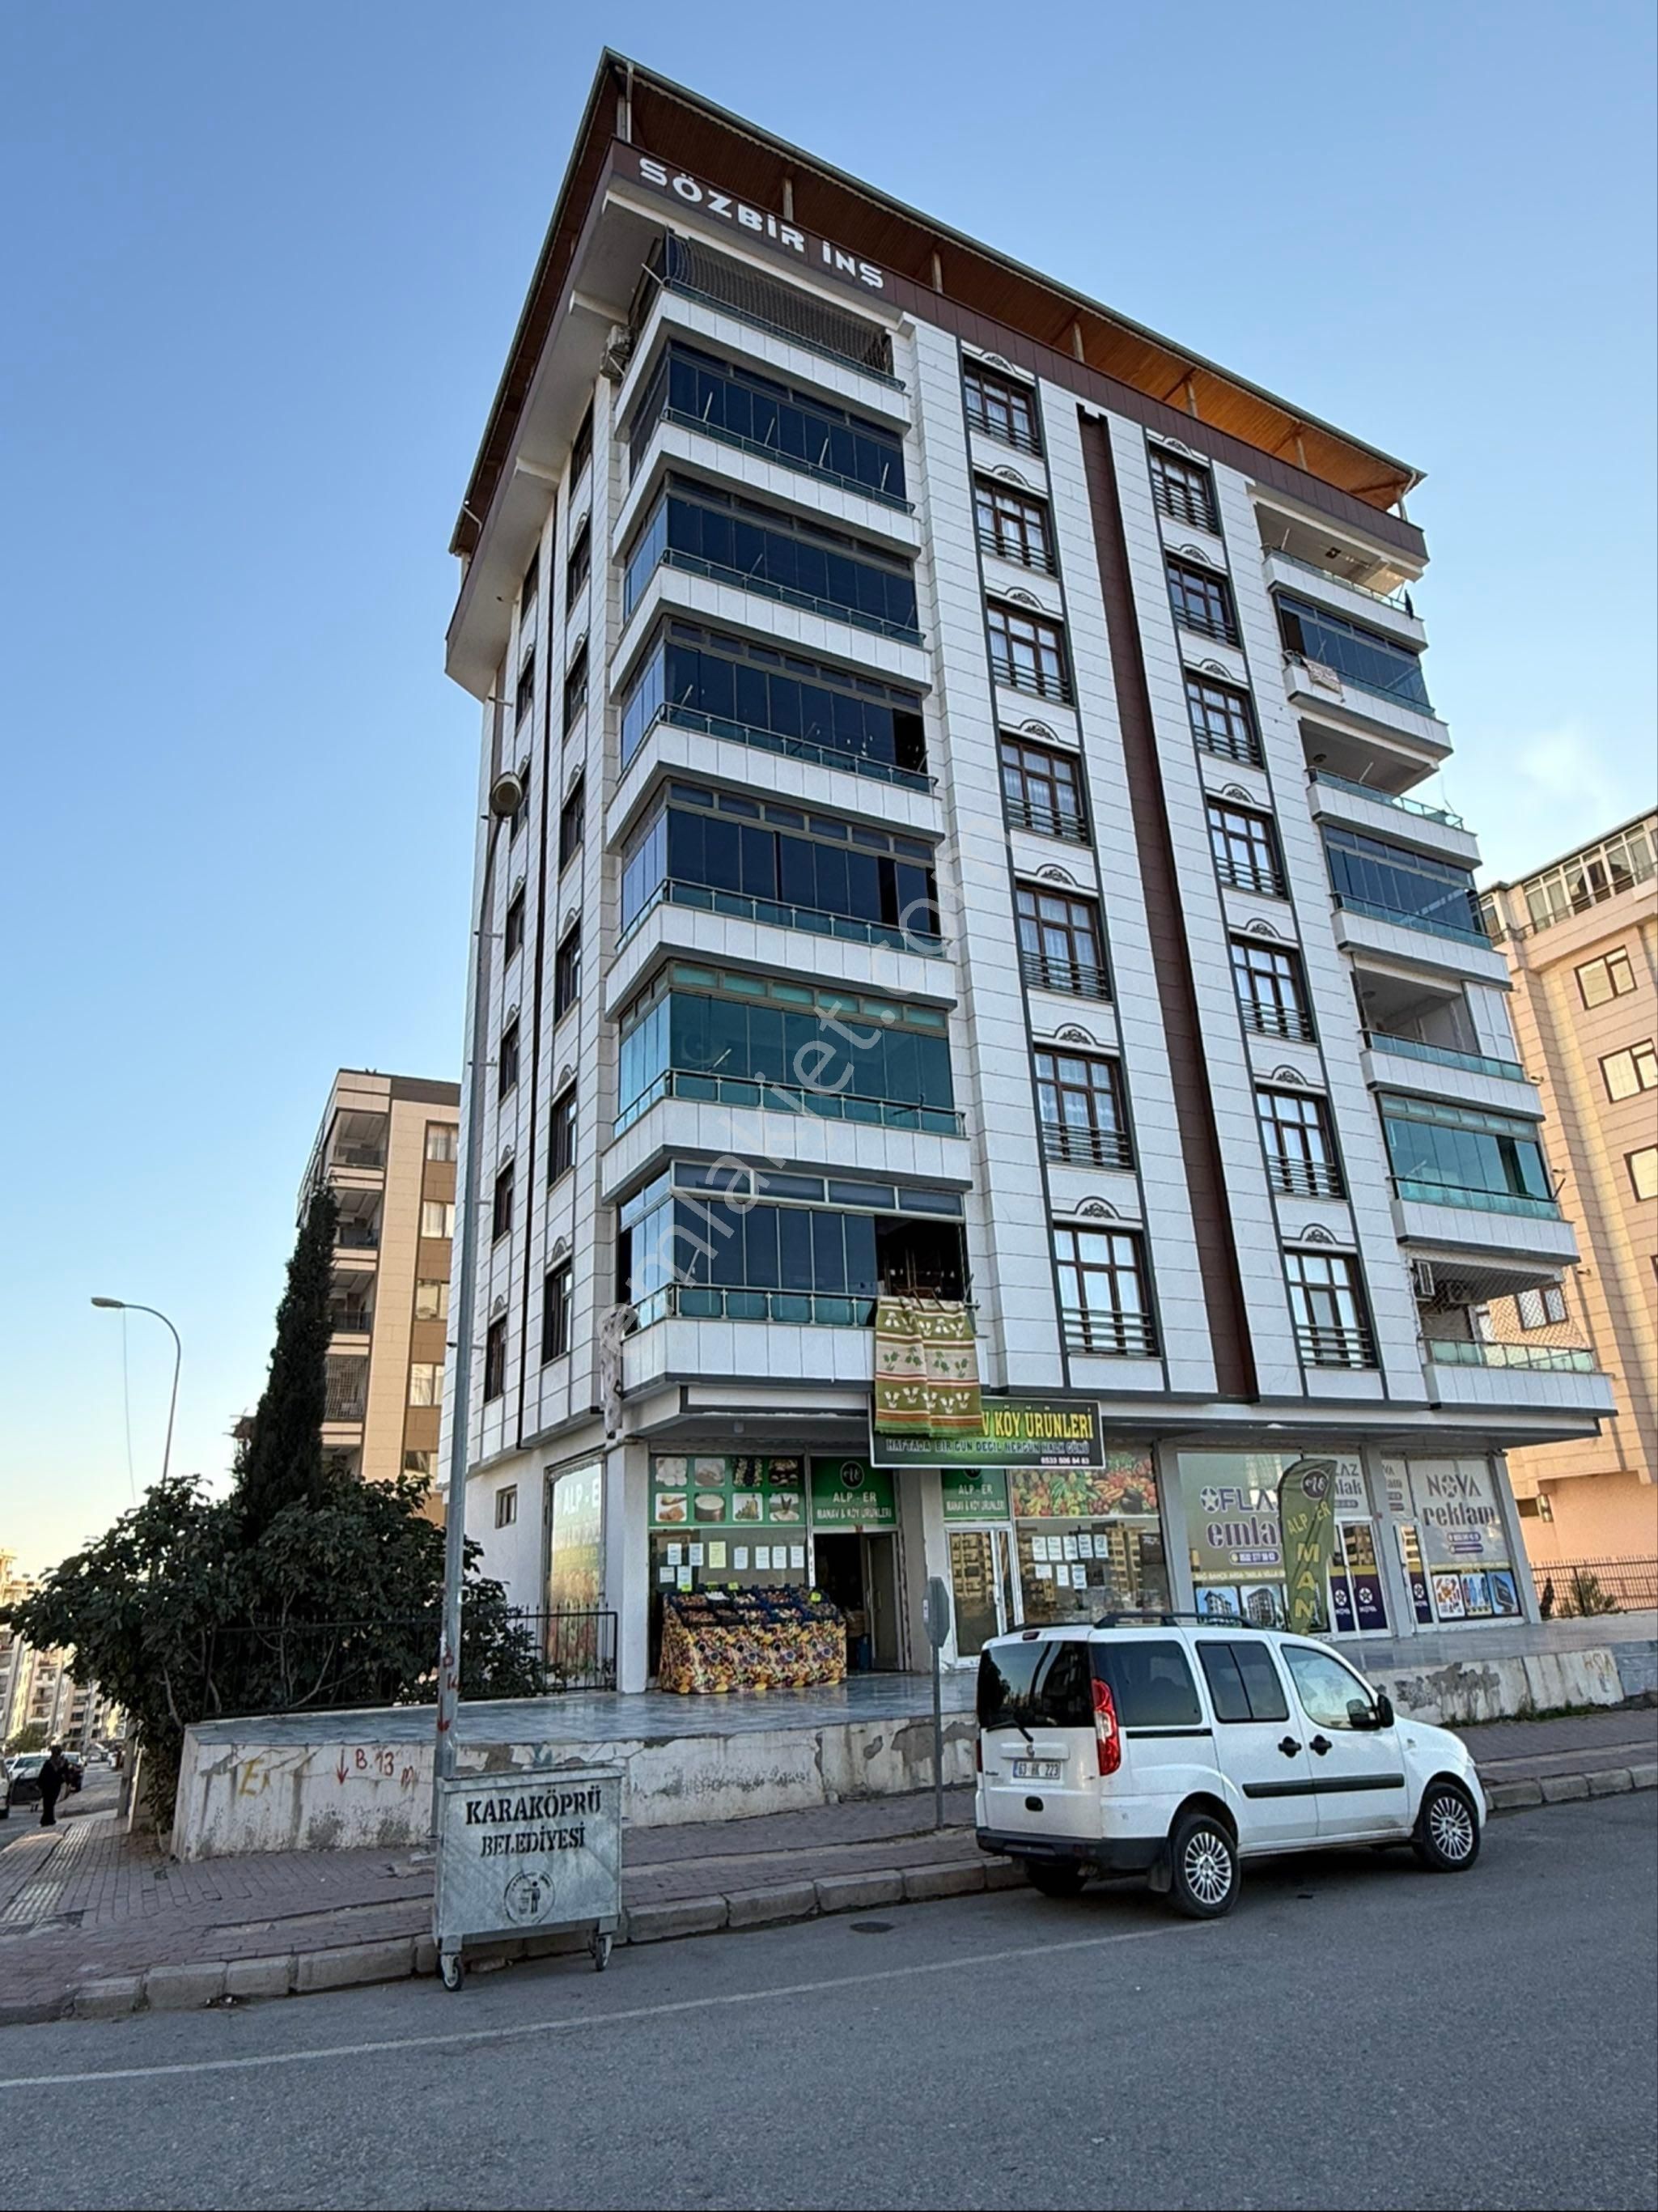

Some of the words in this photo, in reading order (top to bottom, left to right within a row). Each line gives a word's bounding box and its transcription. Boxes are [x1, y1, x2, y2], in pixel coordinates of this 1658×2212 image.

[639, 157, 805, 253] SÖZBİR
[822, 241, 884, 289] İNŞ
[994, 1405, 1020, 1437] KÖY
[1024, 1406, 1093, 1439] ÜRÜNLERİ
[833, 1492, 853, 1502] ALP
[863, 1492, 876, 1502] ER
[958, 1484, 974, 1495] ALP
[981, 1484, 993, 1495] ER
[1426, 1474, 1482, 1497] NOVA
[1287, 1513, 1308, 1535] ALP
[1423, 1502, 1495, 1526] reklam
[1206, 1515, 1278, 1548] emla
[465, 1785, 601, 1825] KARAKÖPRÜ
[481, 1822, 586, 1857] BELEDİYESİ
